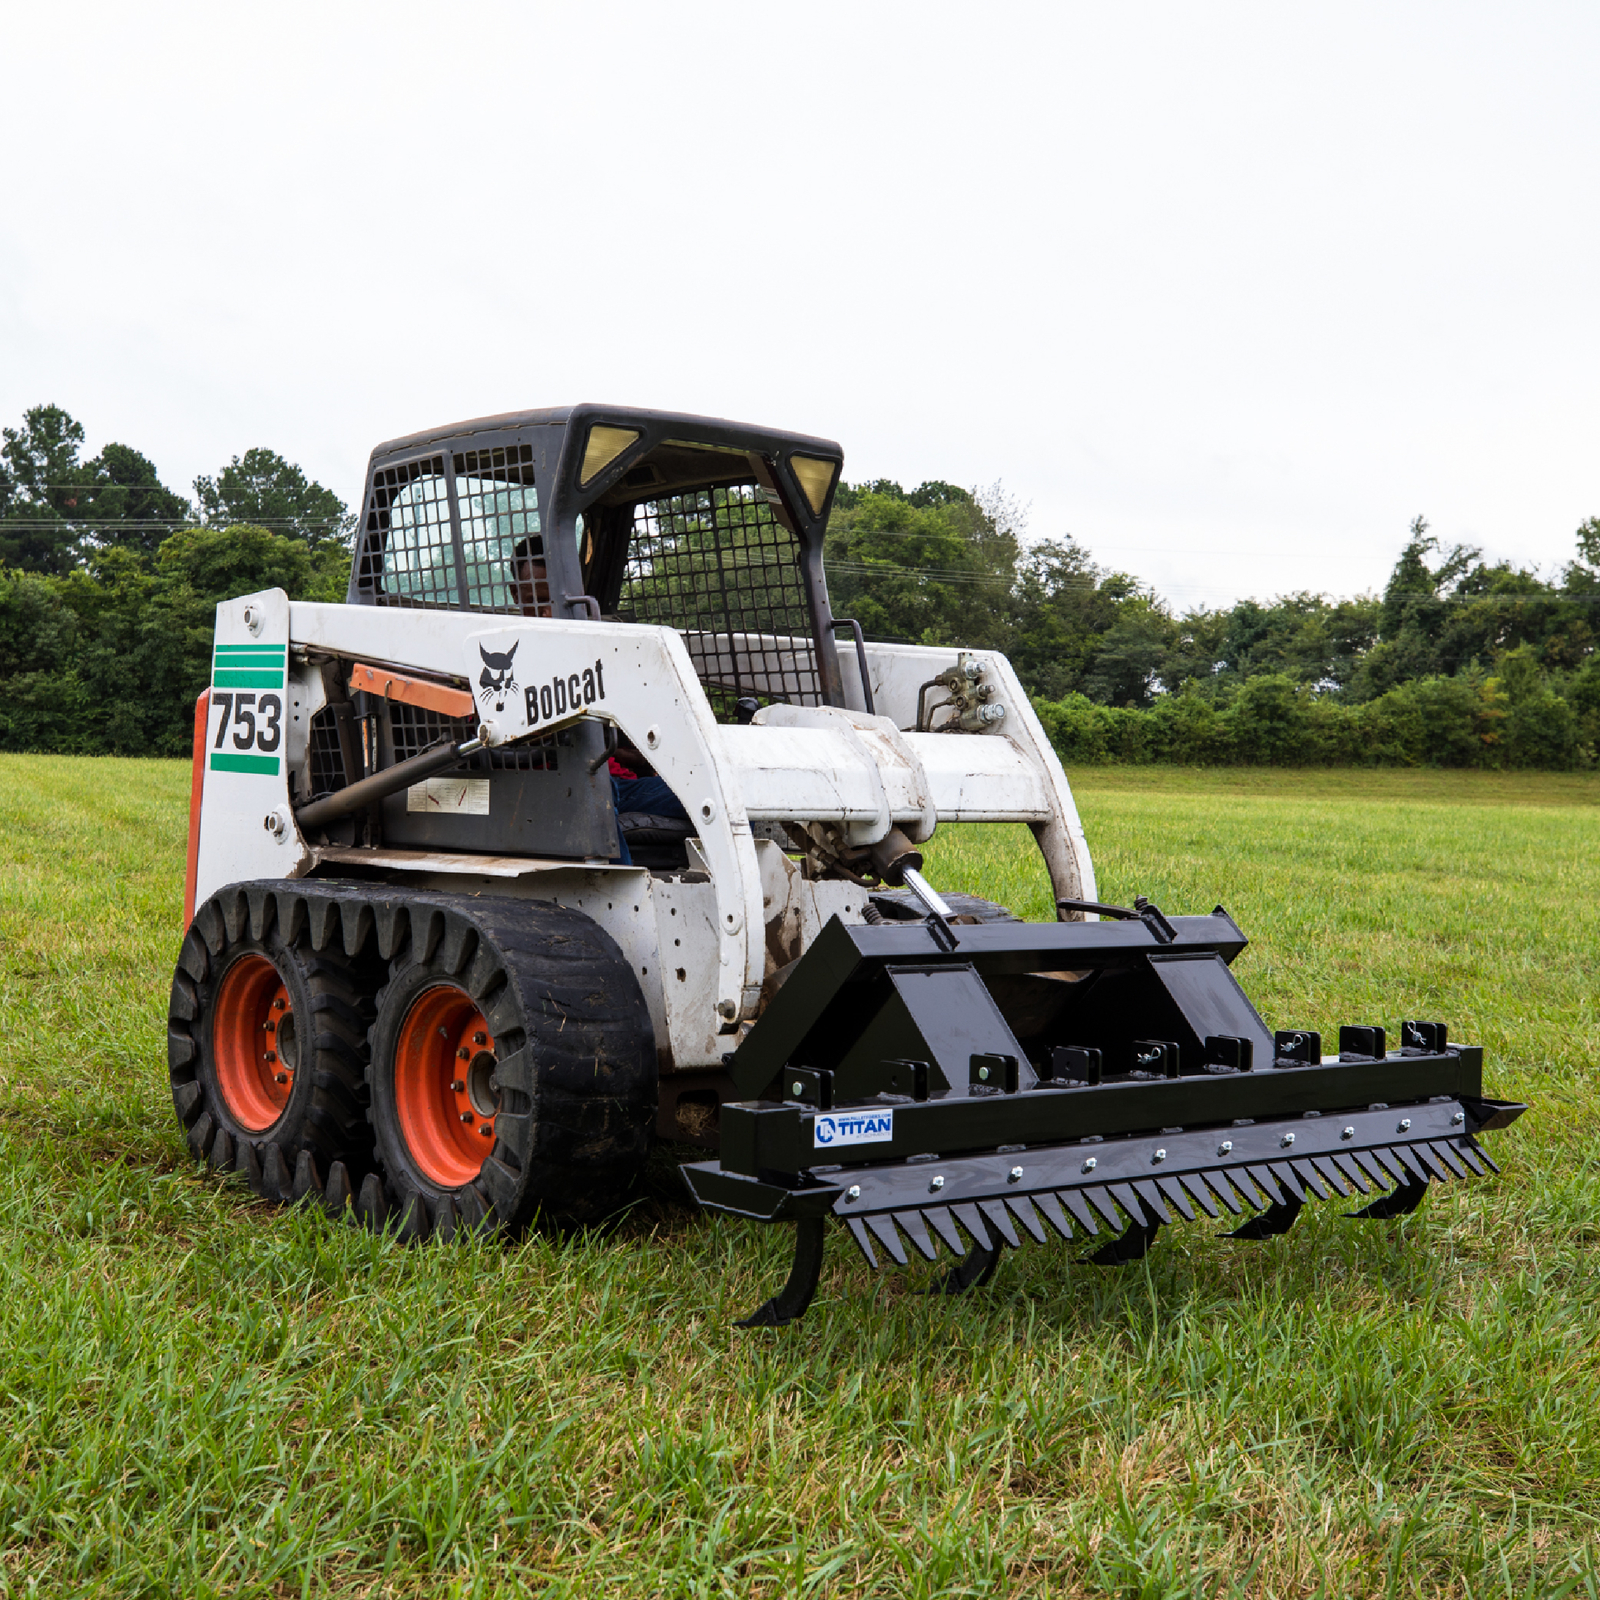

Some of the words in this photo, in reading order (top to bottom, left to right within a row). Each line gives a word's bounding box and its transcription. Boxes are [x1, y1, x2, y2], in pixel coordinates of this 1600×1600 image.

[524, 658, 605, 727] Bobcat
[212, 693, 282, 752] 753
[838, 1118, 891, 1136] TITAN
